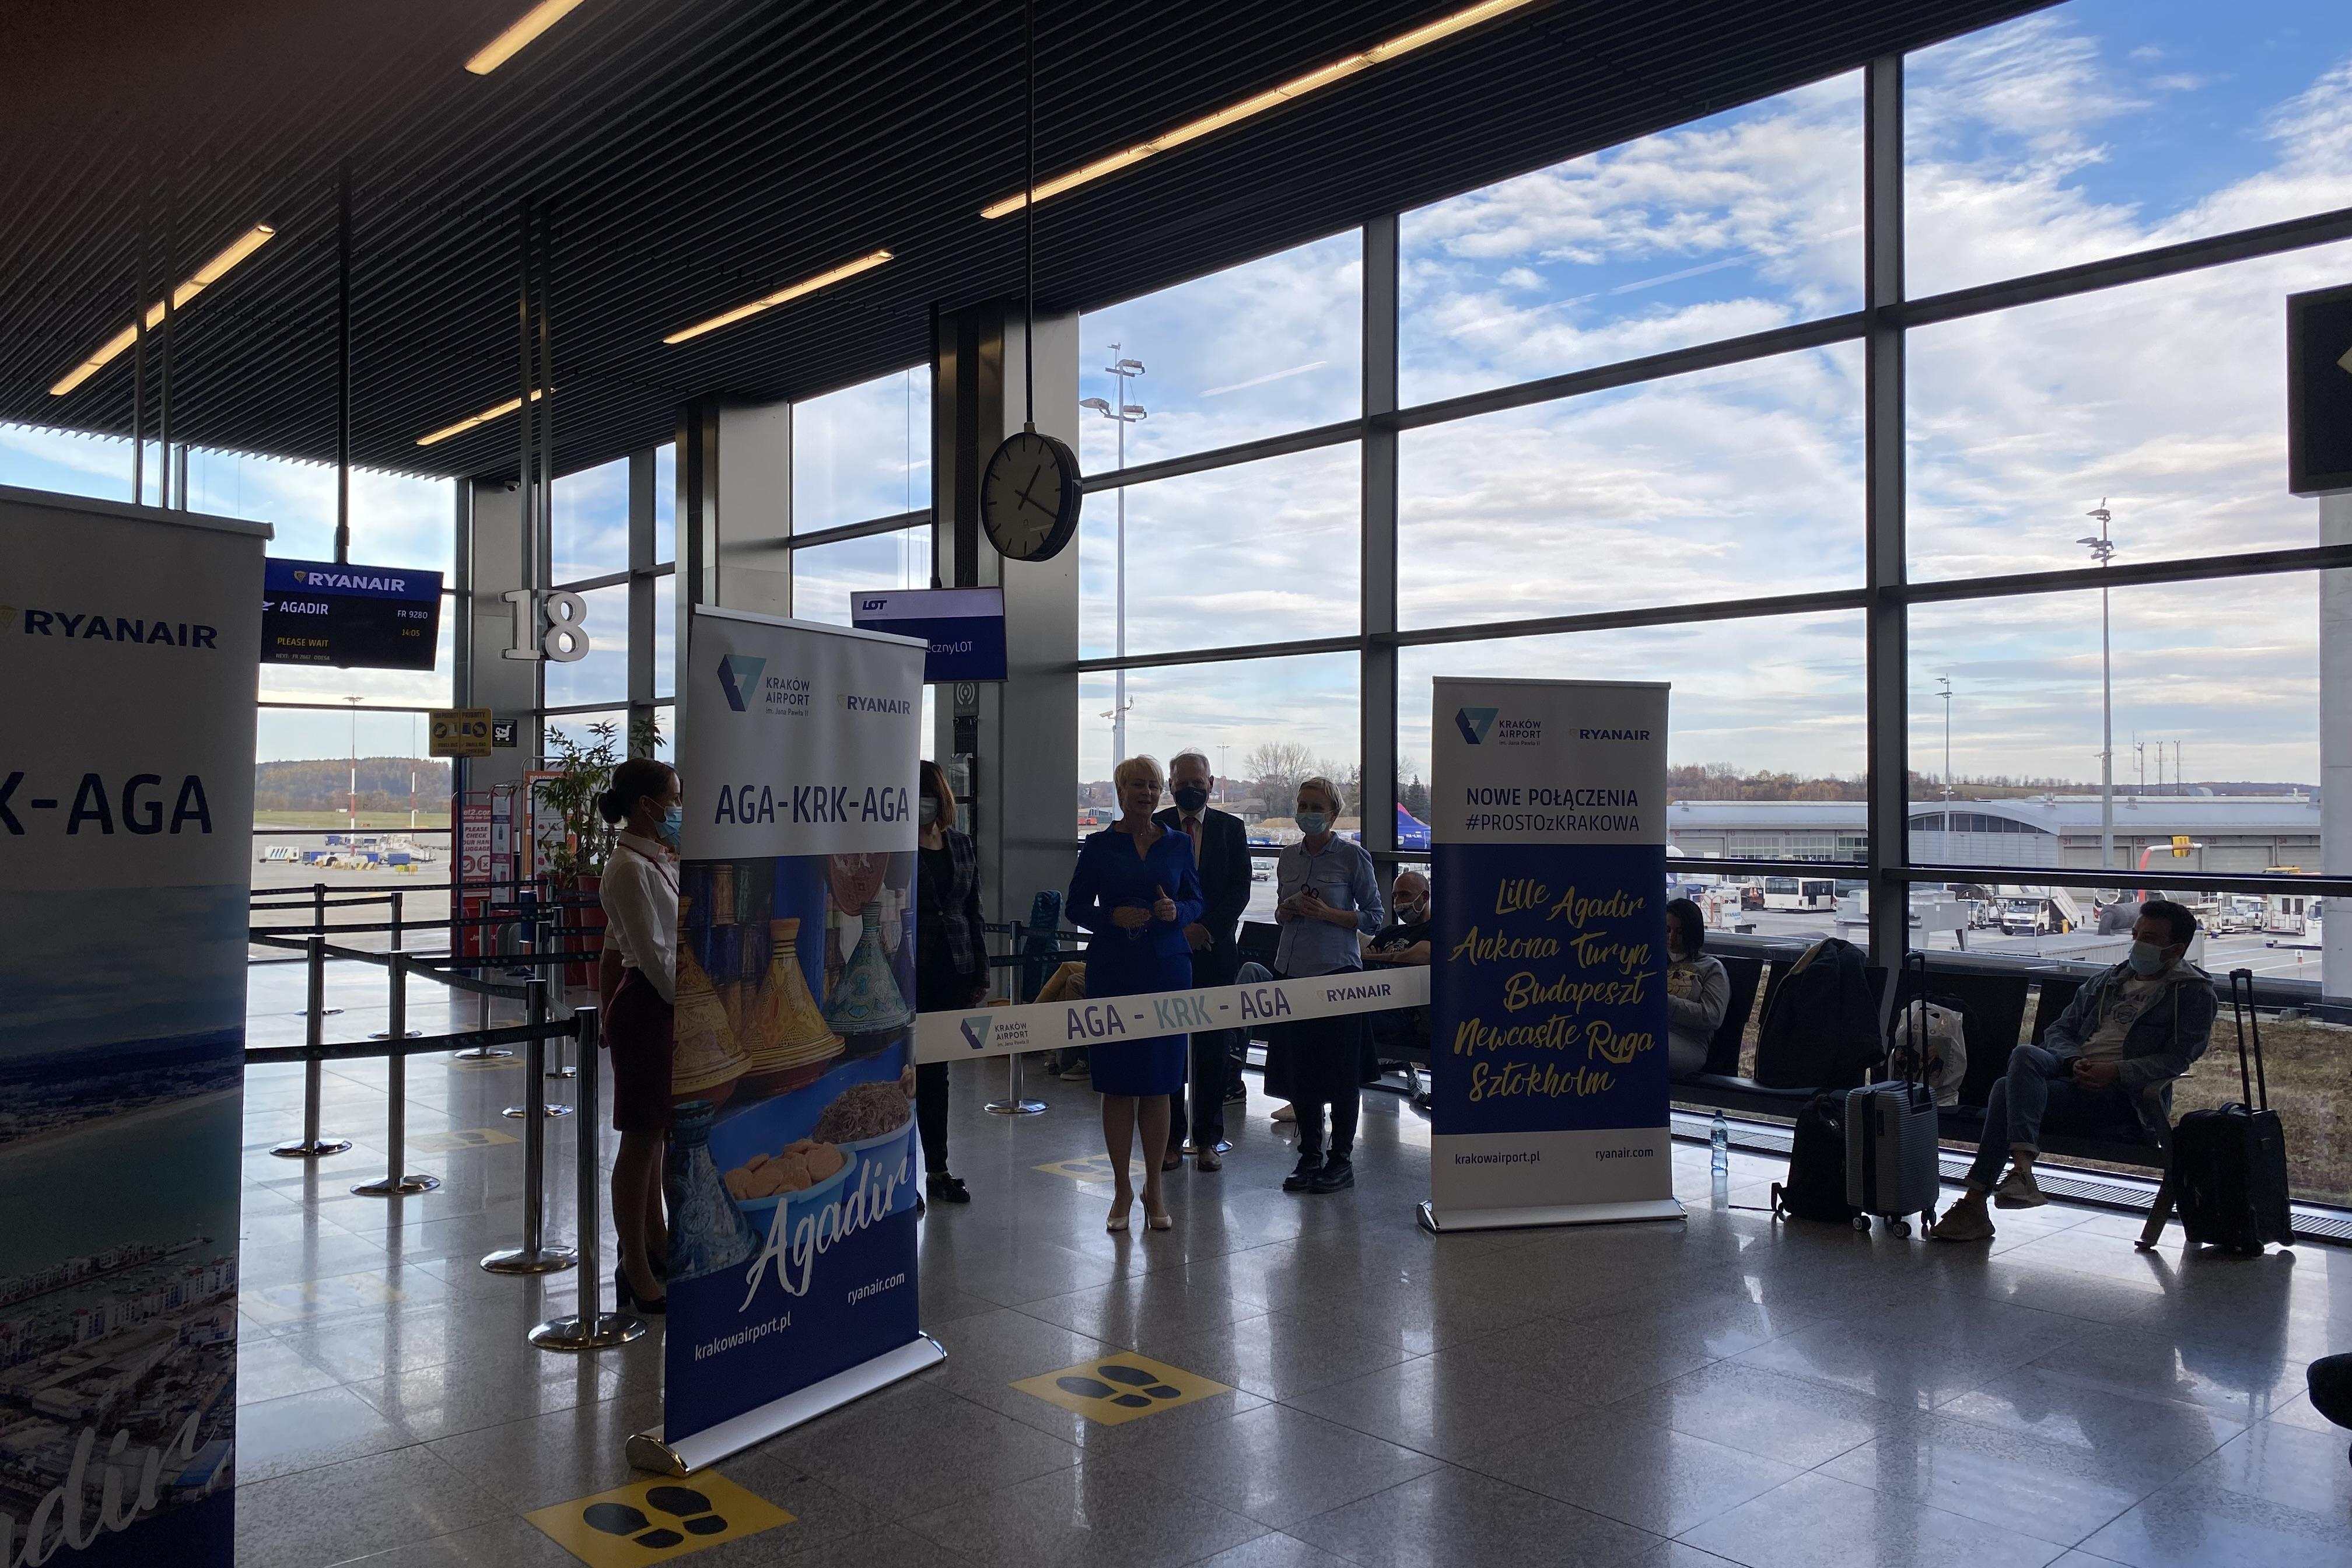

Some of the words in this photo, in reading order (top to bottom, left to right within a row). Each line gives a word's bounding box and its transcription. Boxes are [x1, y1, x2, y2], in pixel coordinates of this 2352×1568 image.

[308, 572, 405, 592] RYANAIR
[280, 601, 329, 615] AGADIR
[409, 611, 428, 619] 9280
[862, 600, 887, 610] LOT
[24, 610, 218, 649] RYANAIR
[501, 589, 590, 662] 18
[277, 638, 306, 647] PLEASE
[309, 639, 328, 648] WAIT
[766, 677, 810, 691] KRAKÓW
[766, 692, 810, 706] AIRPORT
[848, 695, 910, 715] RYANAIR
[1499, 718, 1541, 729] KRAKÓW
[1499, 730, 1541, 738] AIRPORT
[1579, 729, 1650, 741] RYANAIR
[715, 785, 909, 824] AGA-KRK-AGA
[1466, 788, 1521, 806] NOWE
[1528, 789, 1639, 810] POŁĄCZENIA
[1465, 814, 1639, 832] #PROSTOzKRAKOWA
[1496, 878, 1550, 915] Lille
[1545, 886, 1647, 929] Agadir
[1447, 925, 1561, 965] Ankona
[1570, 932, 1653, 975] Turyn
[1503, 971, 1658, 1015] Budapeszt
[1068, 1005, 1126, 1040] AGA
[1153, 995, 1213, 1029] KRK
[1240, 988, 1292, 1020] AGA
[1326, 984, 1392, 1002] RYANAIR
[995, 1022, 1027, 1032] KRAKÓW
[996, 1030, 1028, 1040] AIRPORT
[1454, 1013, 1581, 1058] Newcastle
[1586, 1020, 1656, 1064] Ryga
[1469, 1062, 1616, 1102] Sztokholm
[1455, 1151, 1540, 1165] krakowairport.pl
[1595, 1147, 1653, 1160] ryanair.com
[738, 1157, 913, 1313] Agadir
[848, 1273, 905, 1306] ryanair.com
[695, 1311, 791, 1362] krakowairport.pl
